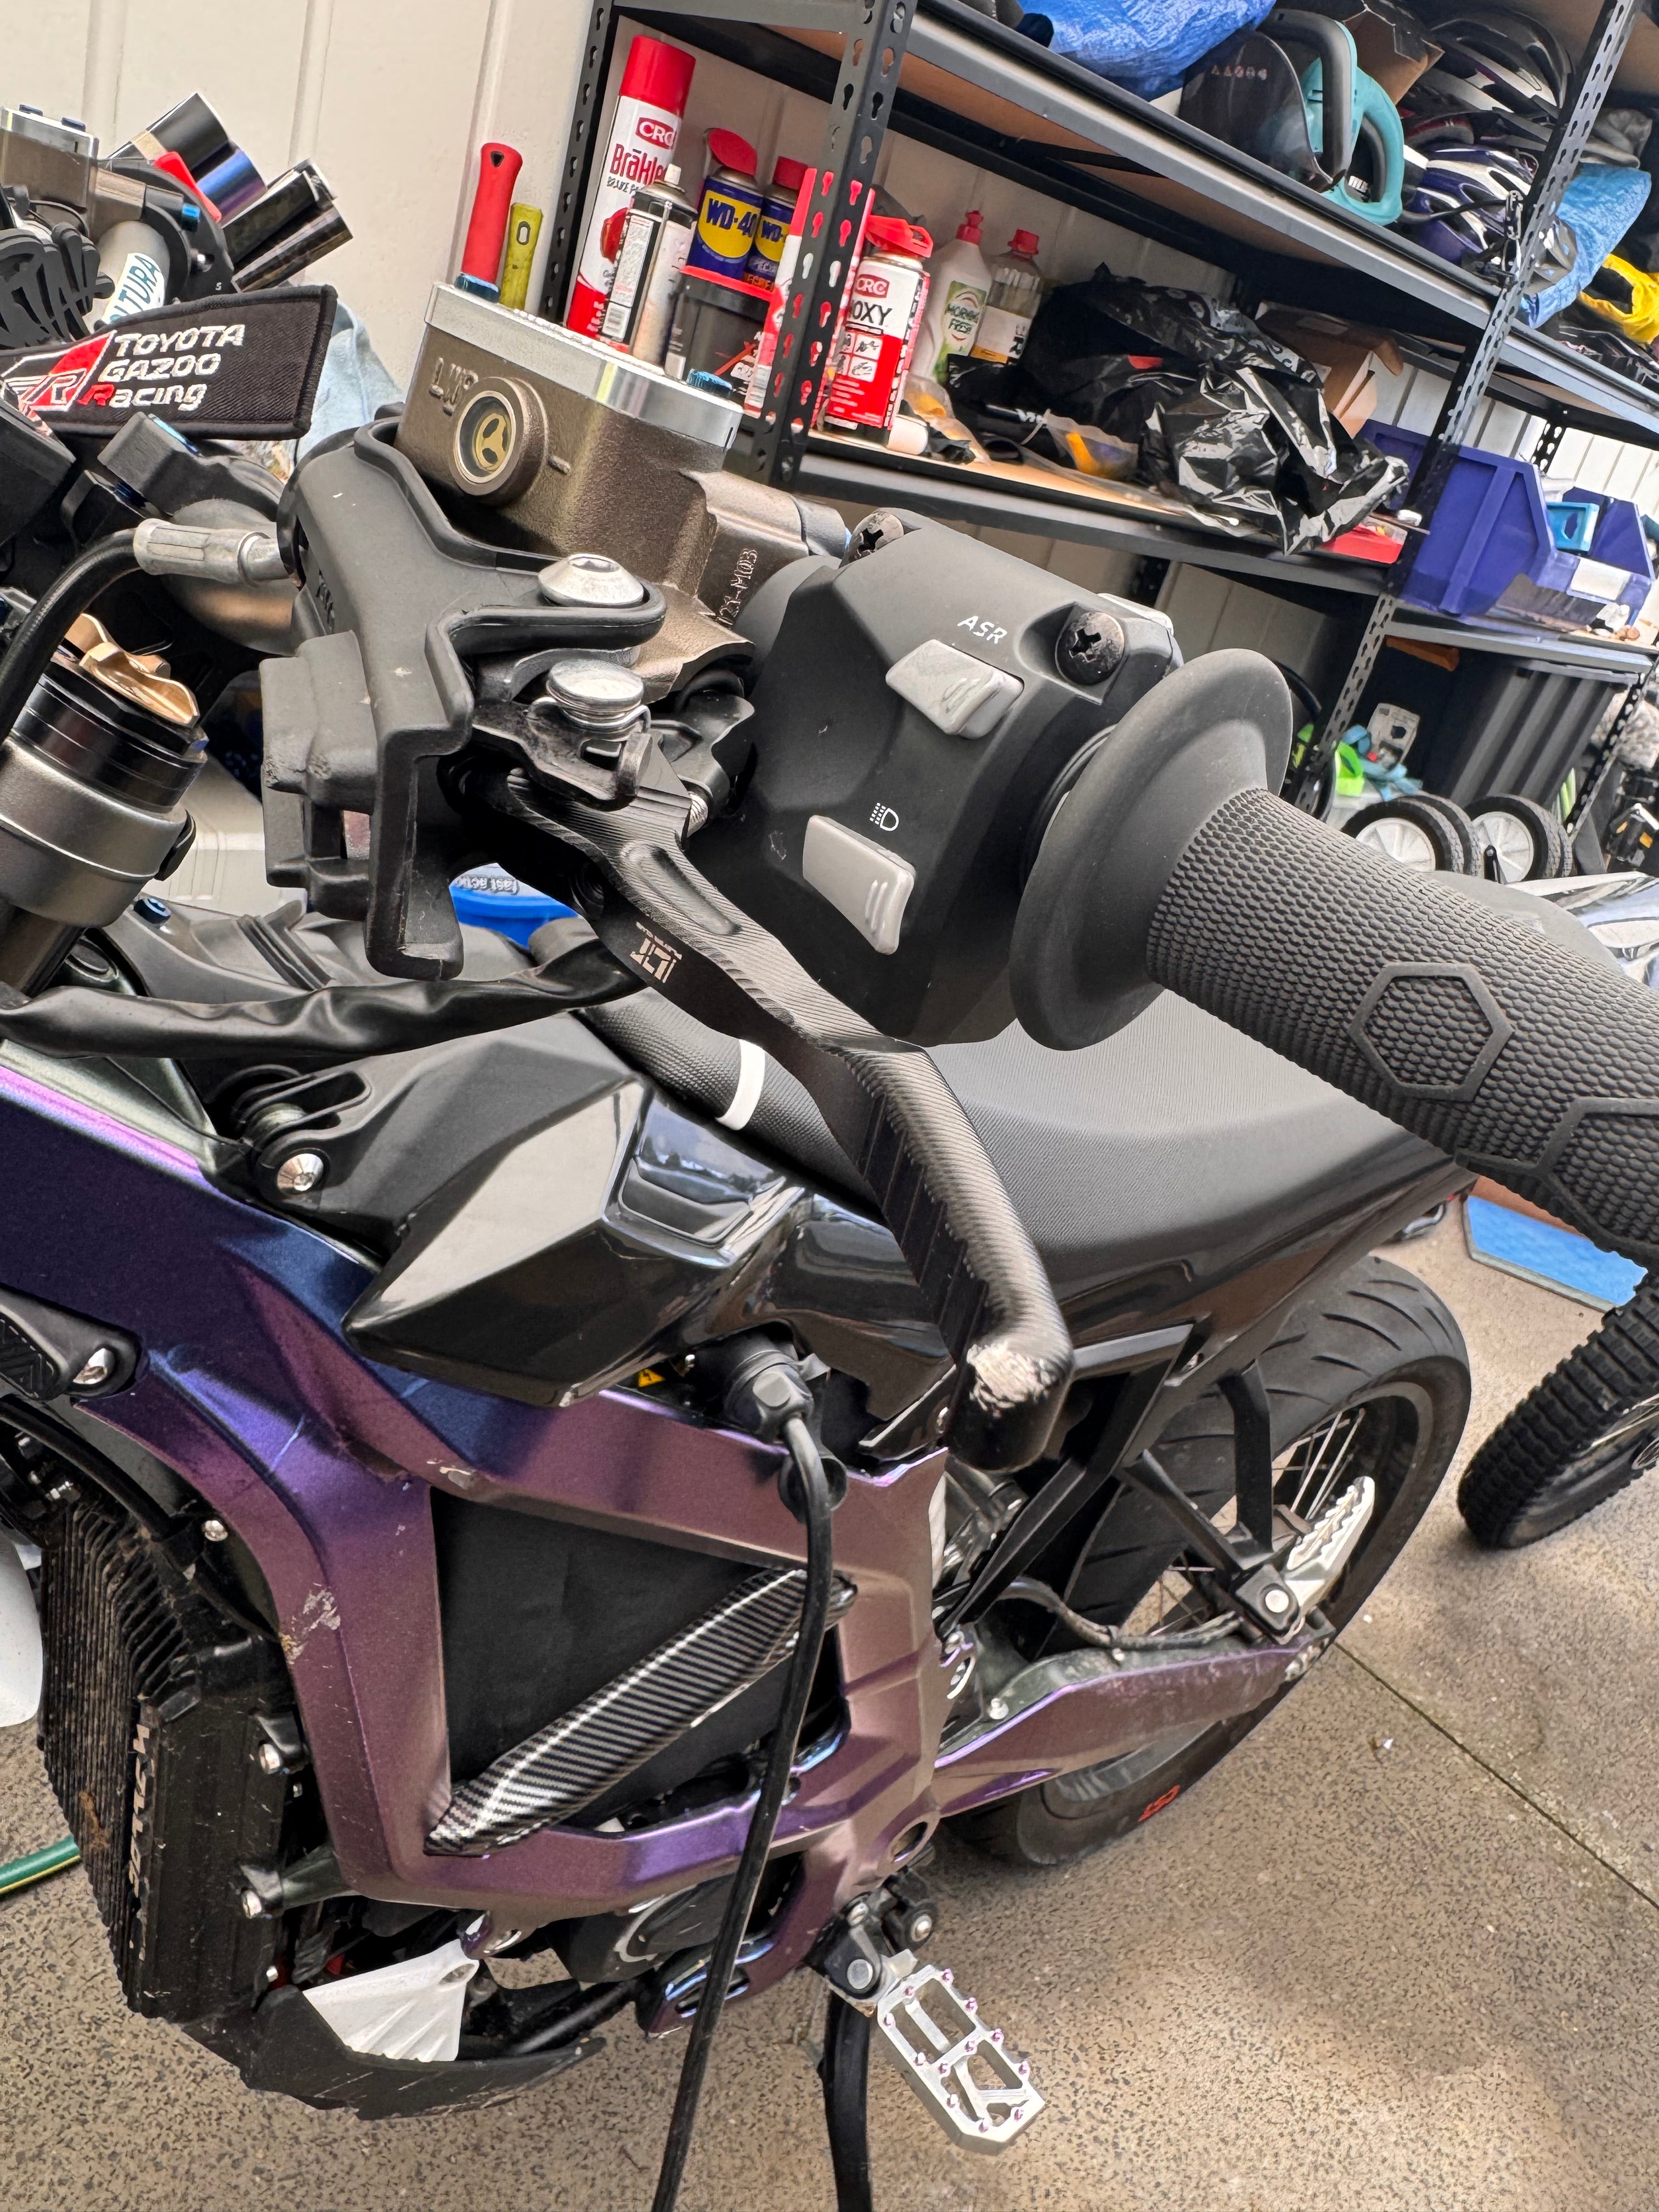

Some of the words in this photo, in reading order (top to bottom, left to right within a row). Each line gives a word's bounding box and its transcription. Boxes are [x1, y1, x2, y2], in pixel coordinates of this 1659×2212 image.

[639, 121, 675, 147] CRC
[706, 198, 758, 238] WD-40
[761, 219, 784, 242] WD-
[855, 278, 887, 296] CRC
[850, 301, 892, 326] OXY
[114, 324, 246, 357] TOYOTA
[98, 353, 221, 382] GAZOO
[76, 383, 207, 411] Racing
[957, 616, 1008, 644] ASR
